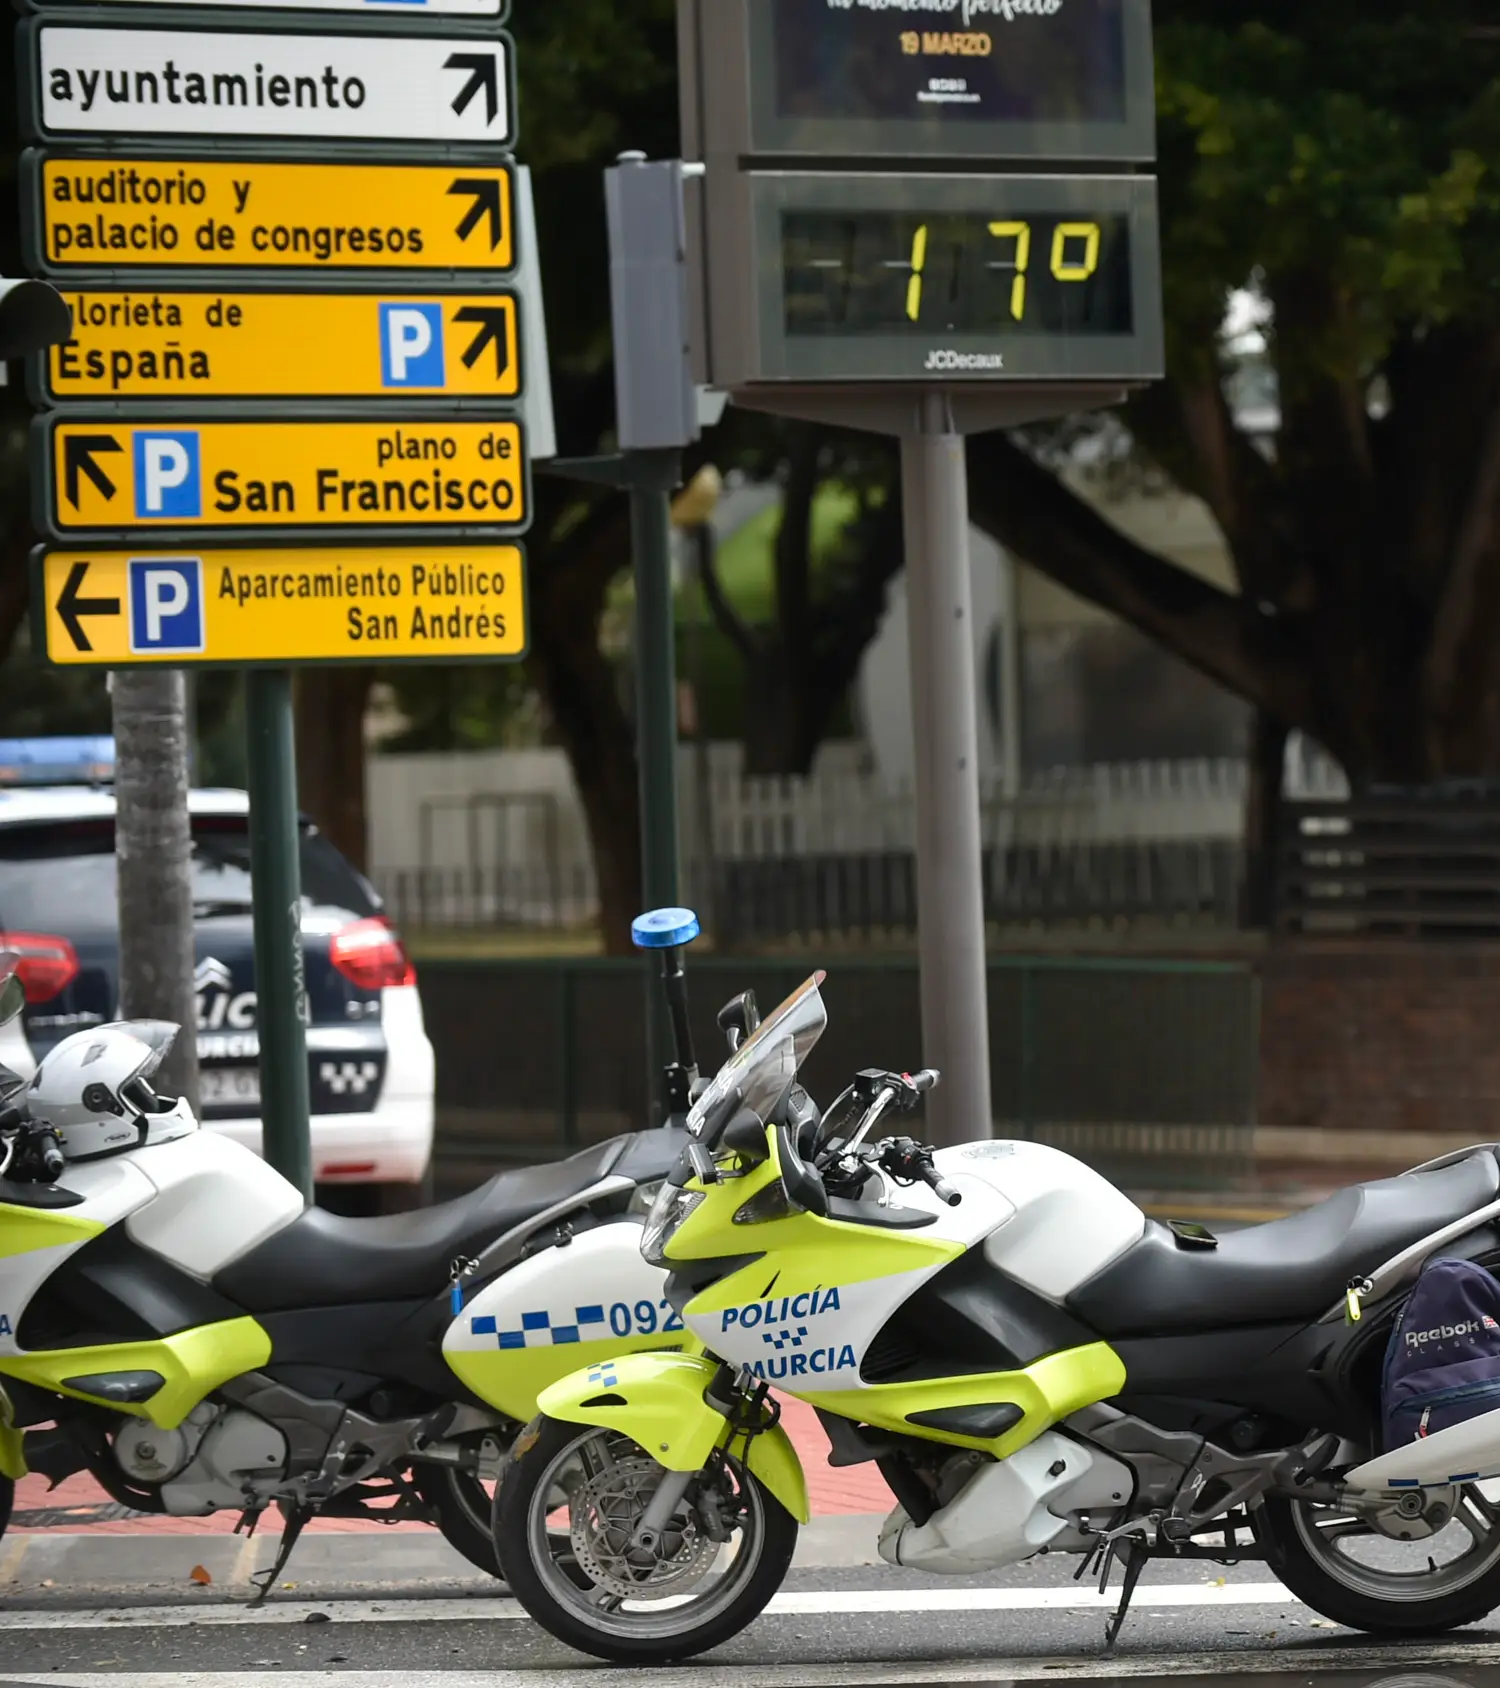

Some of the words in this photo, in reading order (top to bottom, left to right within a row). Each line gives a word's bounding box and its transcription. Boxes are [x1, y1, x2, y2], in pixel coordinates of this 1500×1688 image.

[899, 32, 920, 55] 19
[921, 32, 992, 57] MARZO
[49, 60, 366, 111] ayuntamiento
[52, 169, 206, 205] auditorio
[232, 180, 251, 214] y
[52, 214, 179, 258] palacio
[195, 218, 236, 250] de
[251, 225, 424, 260] congresos
[68, 294, 183, 327] lorieta
[205, 298, 243, 328] de
[59, 340, 211, 390] España
[388, 308, 433, 380] P
[924, 349, 1004, 370] JCDecaux
[376, 430, 457, 468] plano
[477, 432, 512, 460] de
[144, 439, 190, 511] P
[214, 469, 295, 513] San
[316, 468, 514, 512] Francisco
[144, 570, 189, 641] P
[219, 565, 401, 607] Aparcamiento
[411, 560, 506, 597] Público
[347, 605, 399, 641] San
[410, 604, 507, 640] Andrés
[721, 1284, 841, 1332] POLICÍA
[1405, 1320, 1480, 1348] Reebok
[742, 1344, 857, 1380] MURCIA
